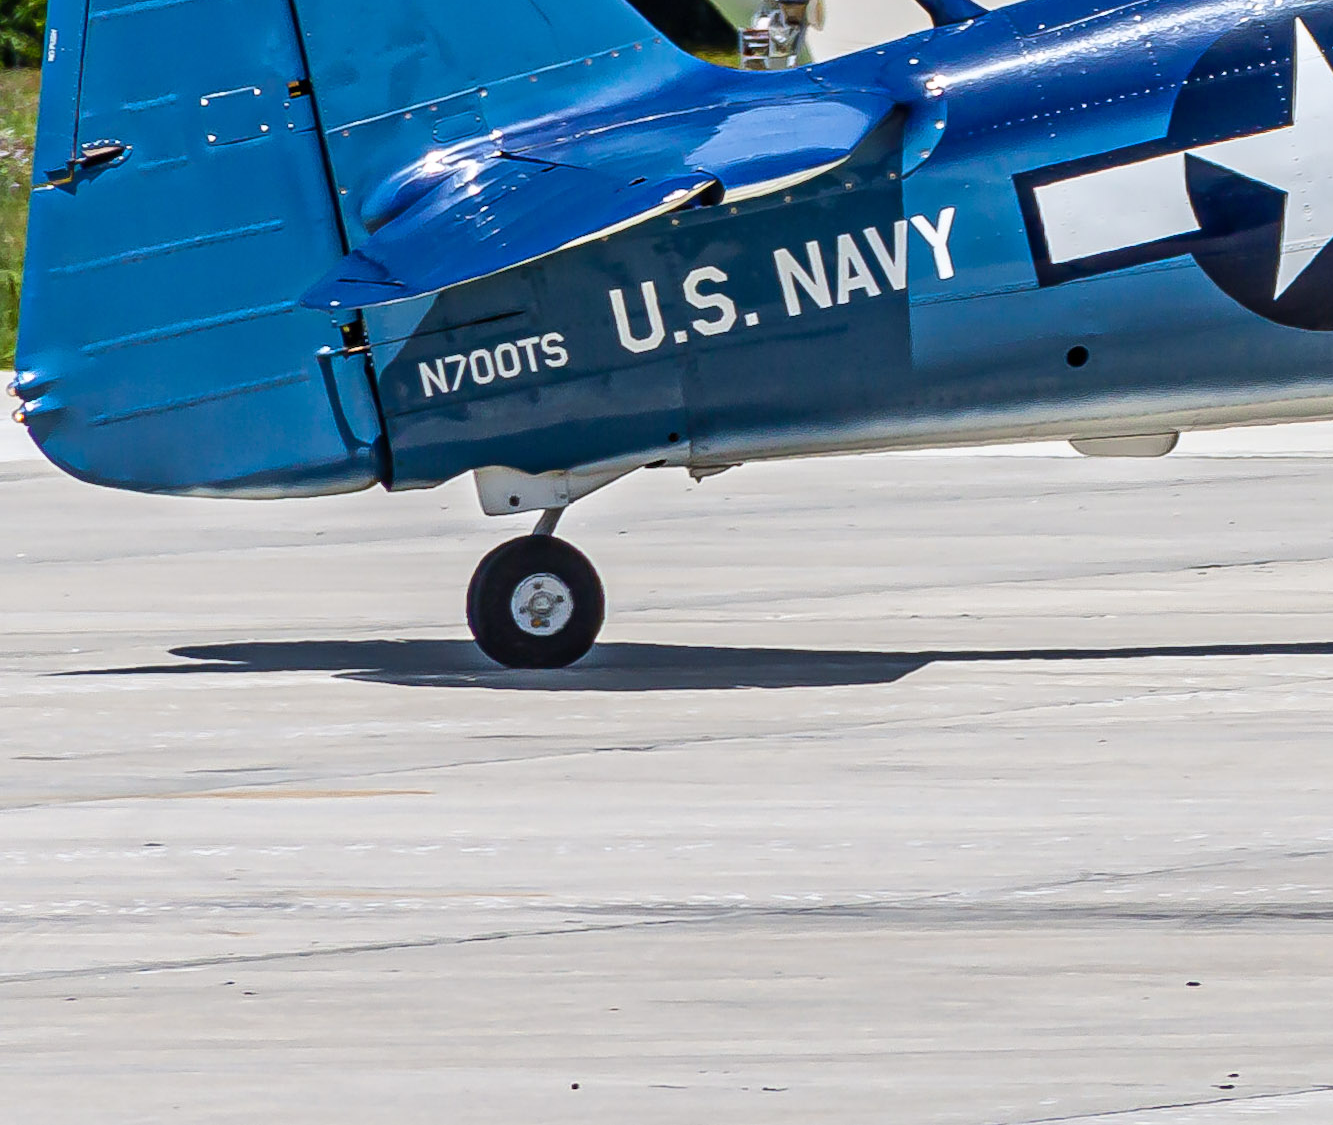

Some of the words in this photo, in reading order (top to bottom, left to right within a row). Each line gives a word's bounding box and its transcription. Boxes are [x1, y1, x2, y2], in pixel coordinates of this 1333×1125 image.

[608, 264, 760, 354] U.S.
[773, 206, 957, 317] NAVY
[418, 332, 569, 397] N700TS
